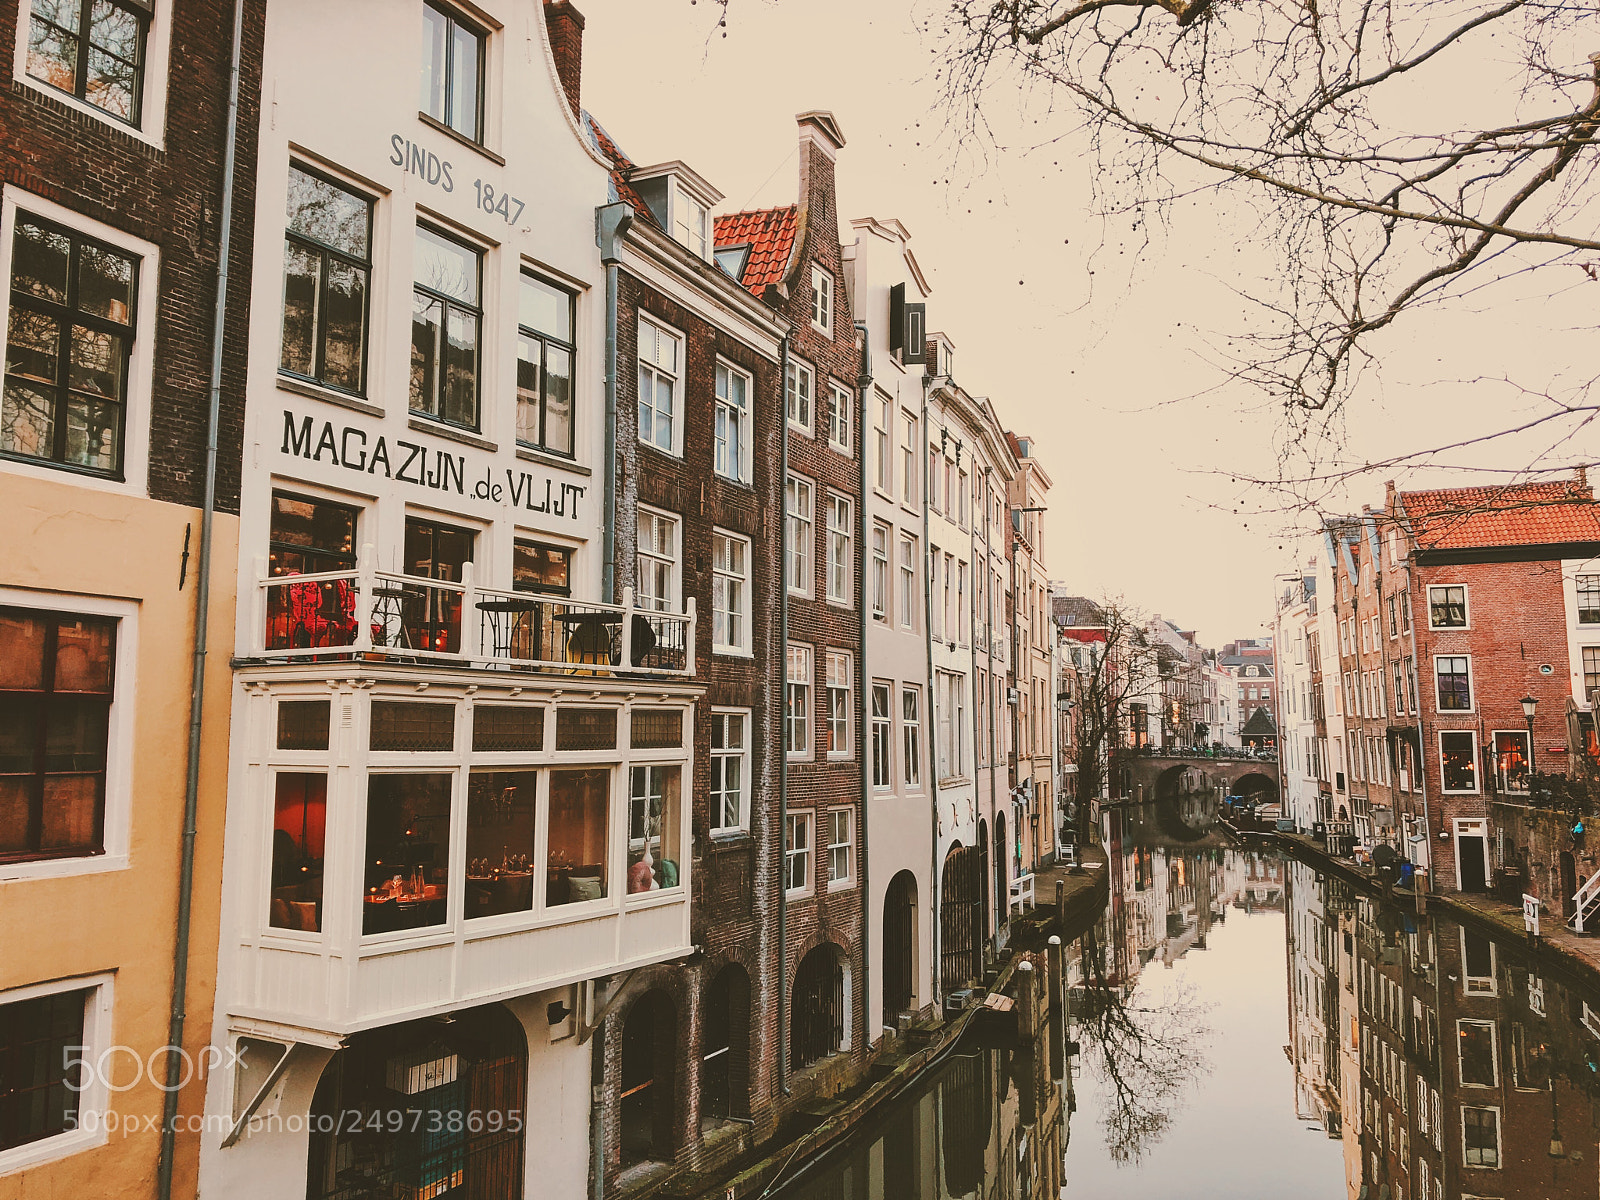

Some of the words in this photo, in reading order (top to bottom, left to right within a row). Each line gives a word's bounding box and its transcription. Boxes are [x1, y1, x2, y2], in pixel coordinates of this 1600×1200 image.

[389, 134, 454, 193] SINDS
[473, 178, 526, 226] 1847
[280, 410, 465, 495] MAGAZIJN
